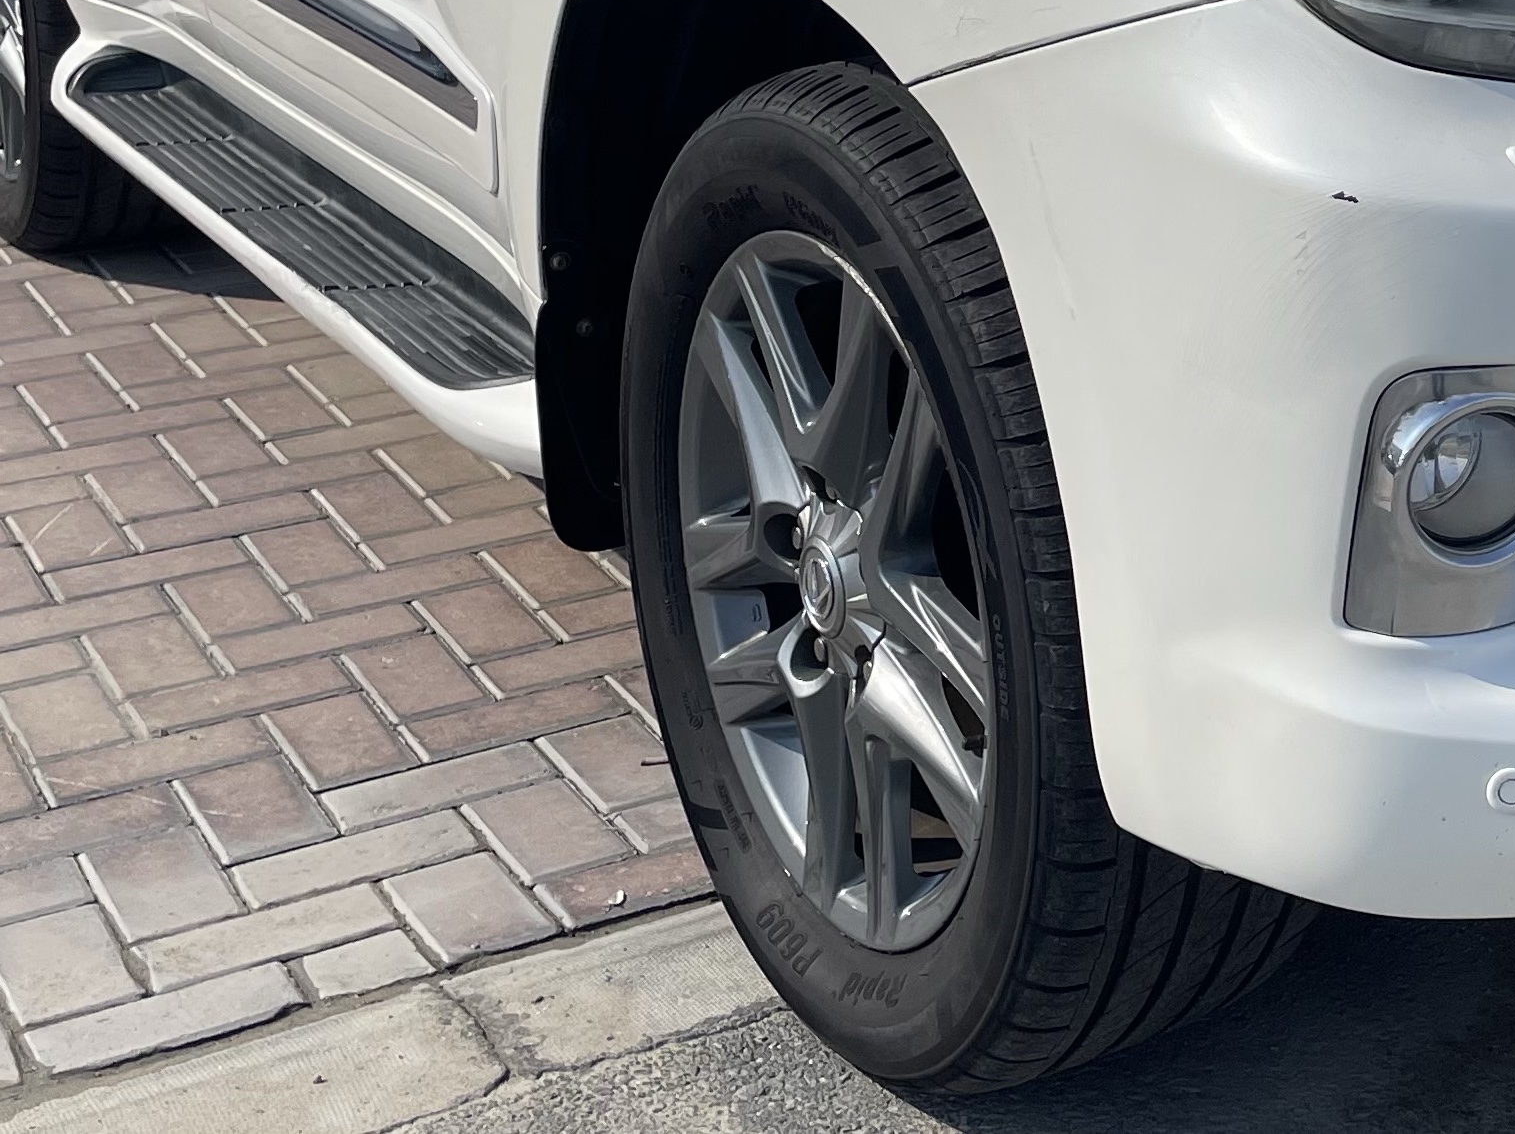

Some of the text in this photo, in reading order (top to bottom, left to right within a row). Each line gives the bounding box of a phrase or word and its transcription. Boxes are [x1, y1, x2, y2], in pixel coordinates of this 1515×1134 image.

[992, 613, 1010, 722] OUTSIDE
[756, 902, 824, 978] P609
[838, 969, 908, 1009] Rapid
